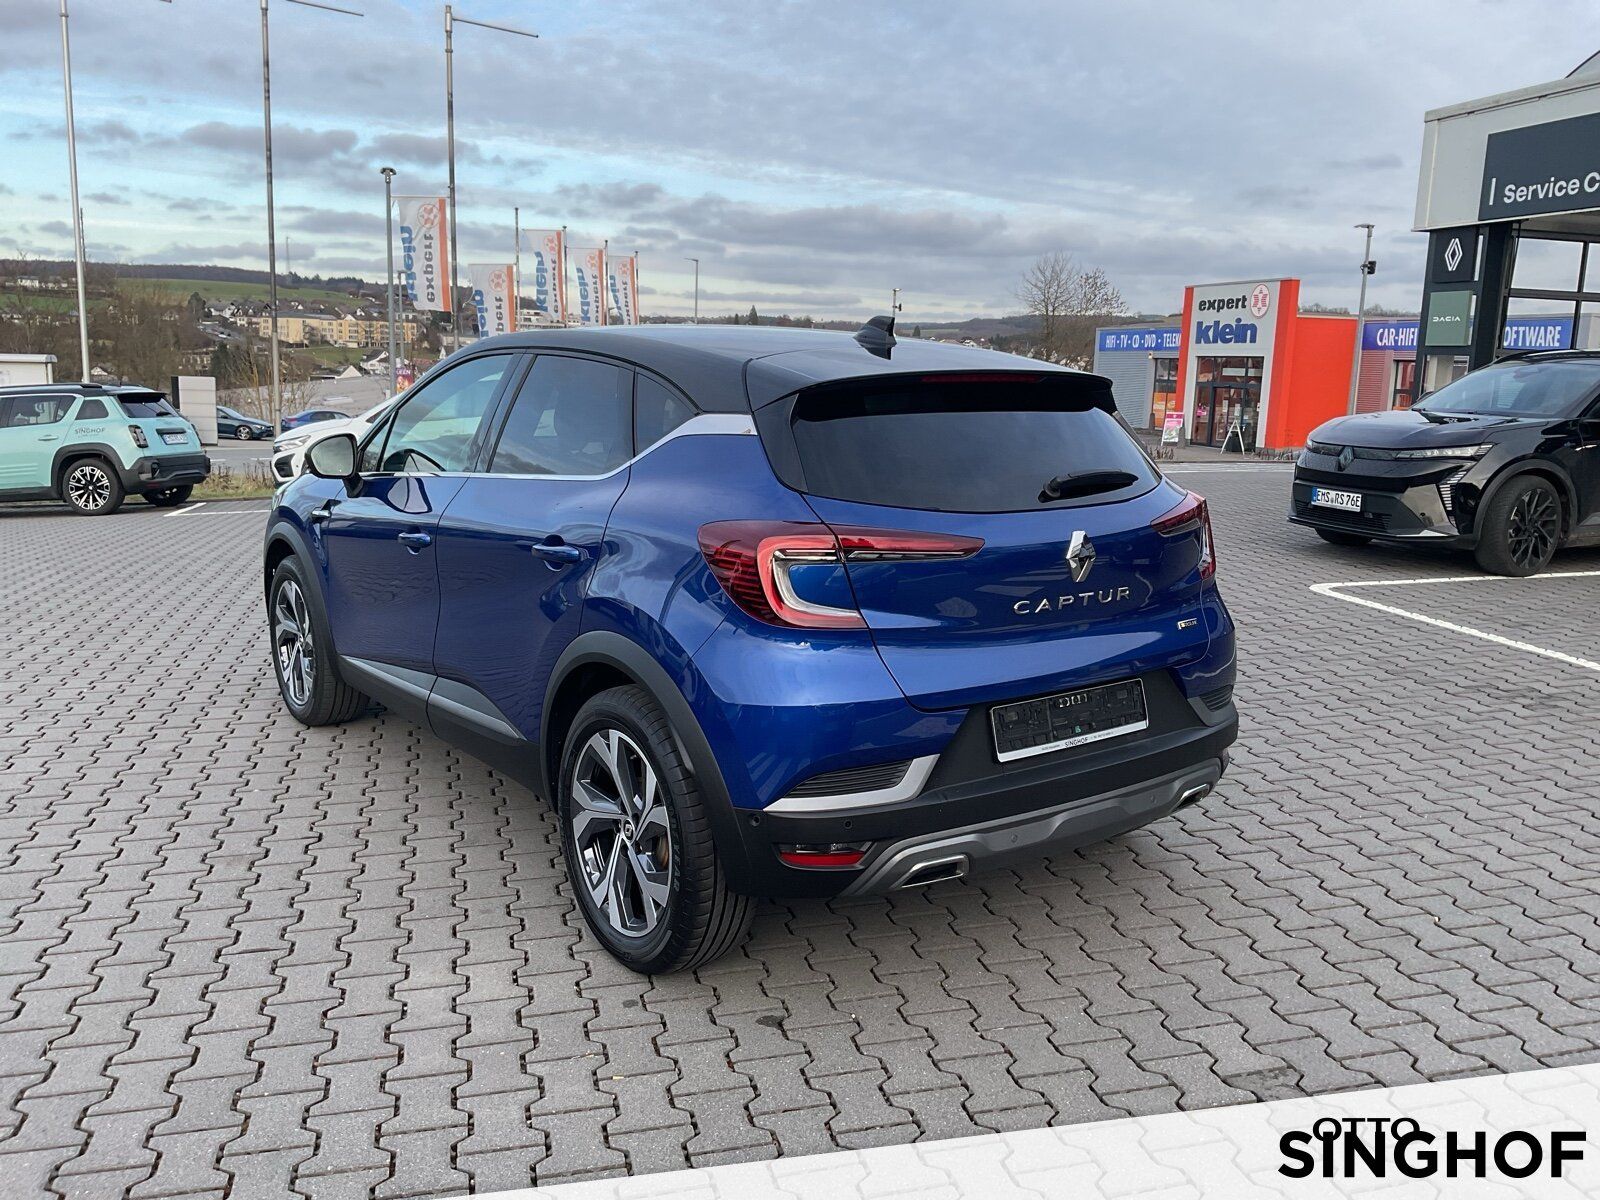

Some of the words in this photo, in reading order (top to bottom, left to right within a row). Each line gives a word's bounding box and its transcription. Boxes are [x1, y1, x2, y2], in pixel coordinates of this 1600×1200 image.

[1503, 177, 1580, 204] Service
[1198, 295, 1247, 313] expert
[1195, 317, 1258, 344] klein
[1376, 327, 1418, 347] CAR-HIFI
[1105, 335, 1116, 348] HIFI
[1120, 335, 1128, 348] TV
[1132, 334, 1140, 348] CD
[1144, 334, 1156, 348] DVD
[1317, 490, 1330, 502] EMS
[1334, 493, 1345, 505] RS
[1345, 495, 1361, 507] 76E
[1013, 586, 1130, 615] CAPTUR
[1064, 736, 1088, 748] SINGHOF
